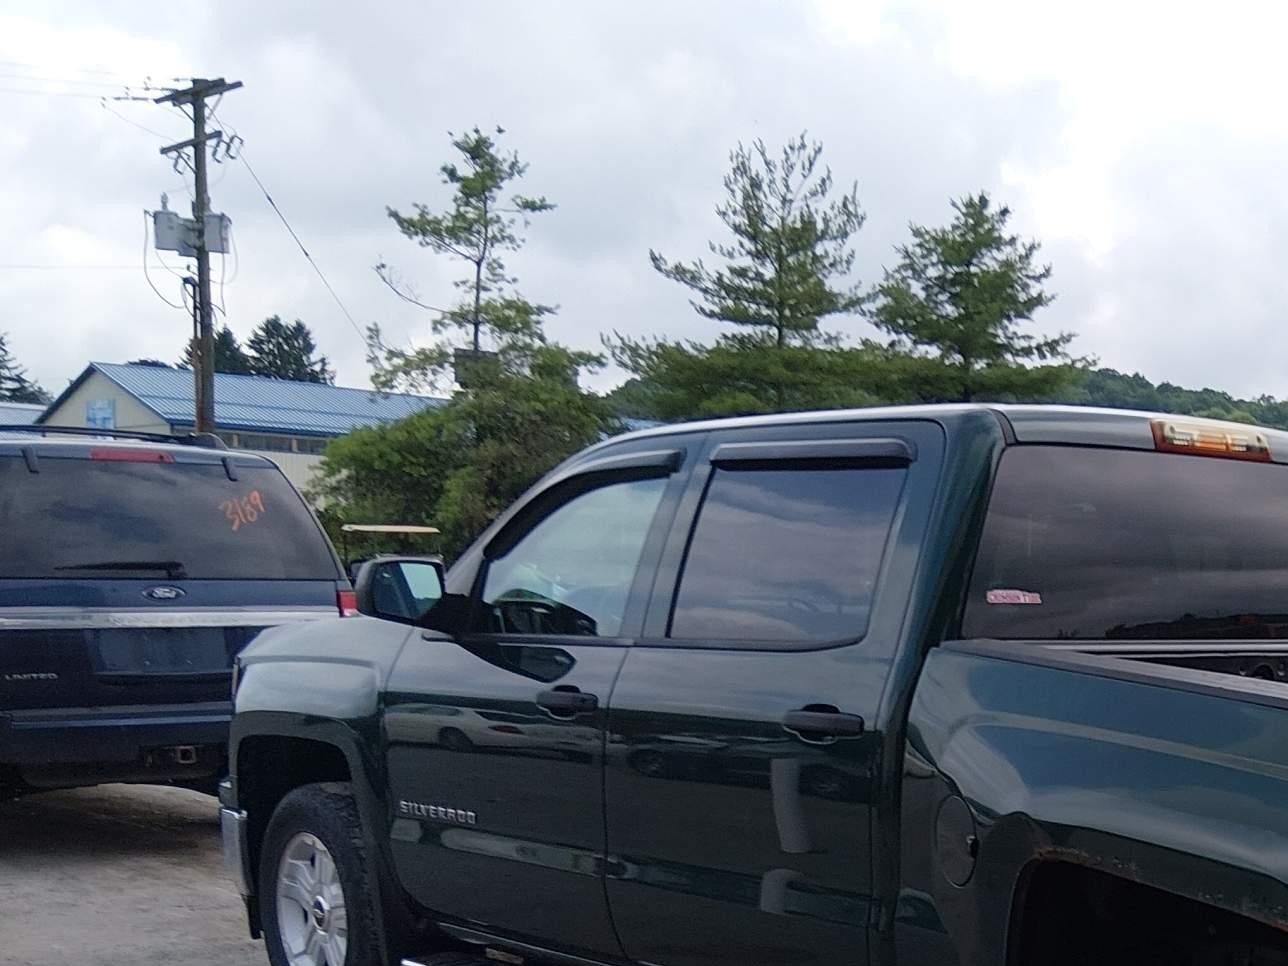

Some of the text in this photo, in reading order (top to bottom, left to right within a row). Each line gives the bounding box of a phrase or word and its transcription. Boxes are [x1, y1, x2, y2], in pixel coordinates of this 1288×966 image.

[217, 488, 265, 531] 3189
[4, 672, 59, 682] LIMITED
[399, 800, 476, 825] SILVERADO
